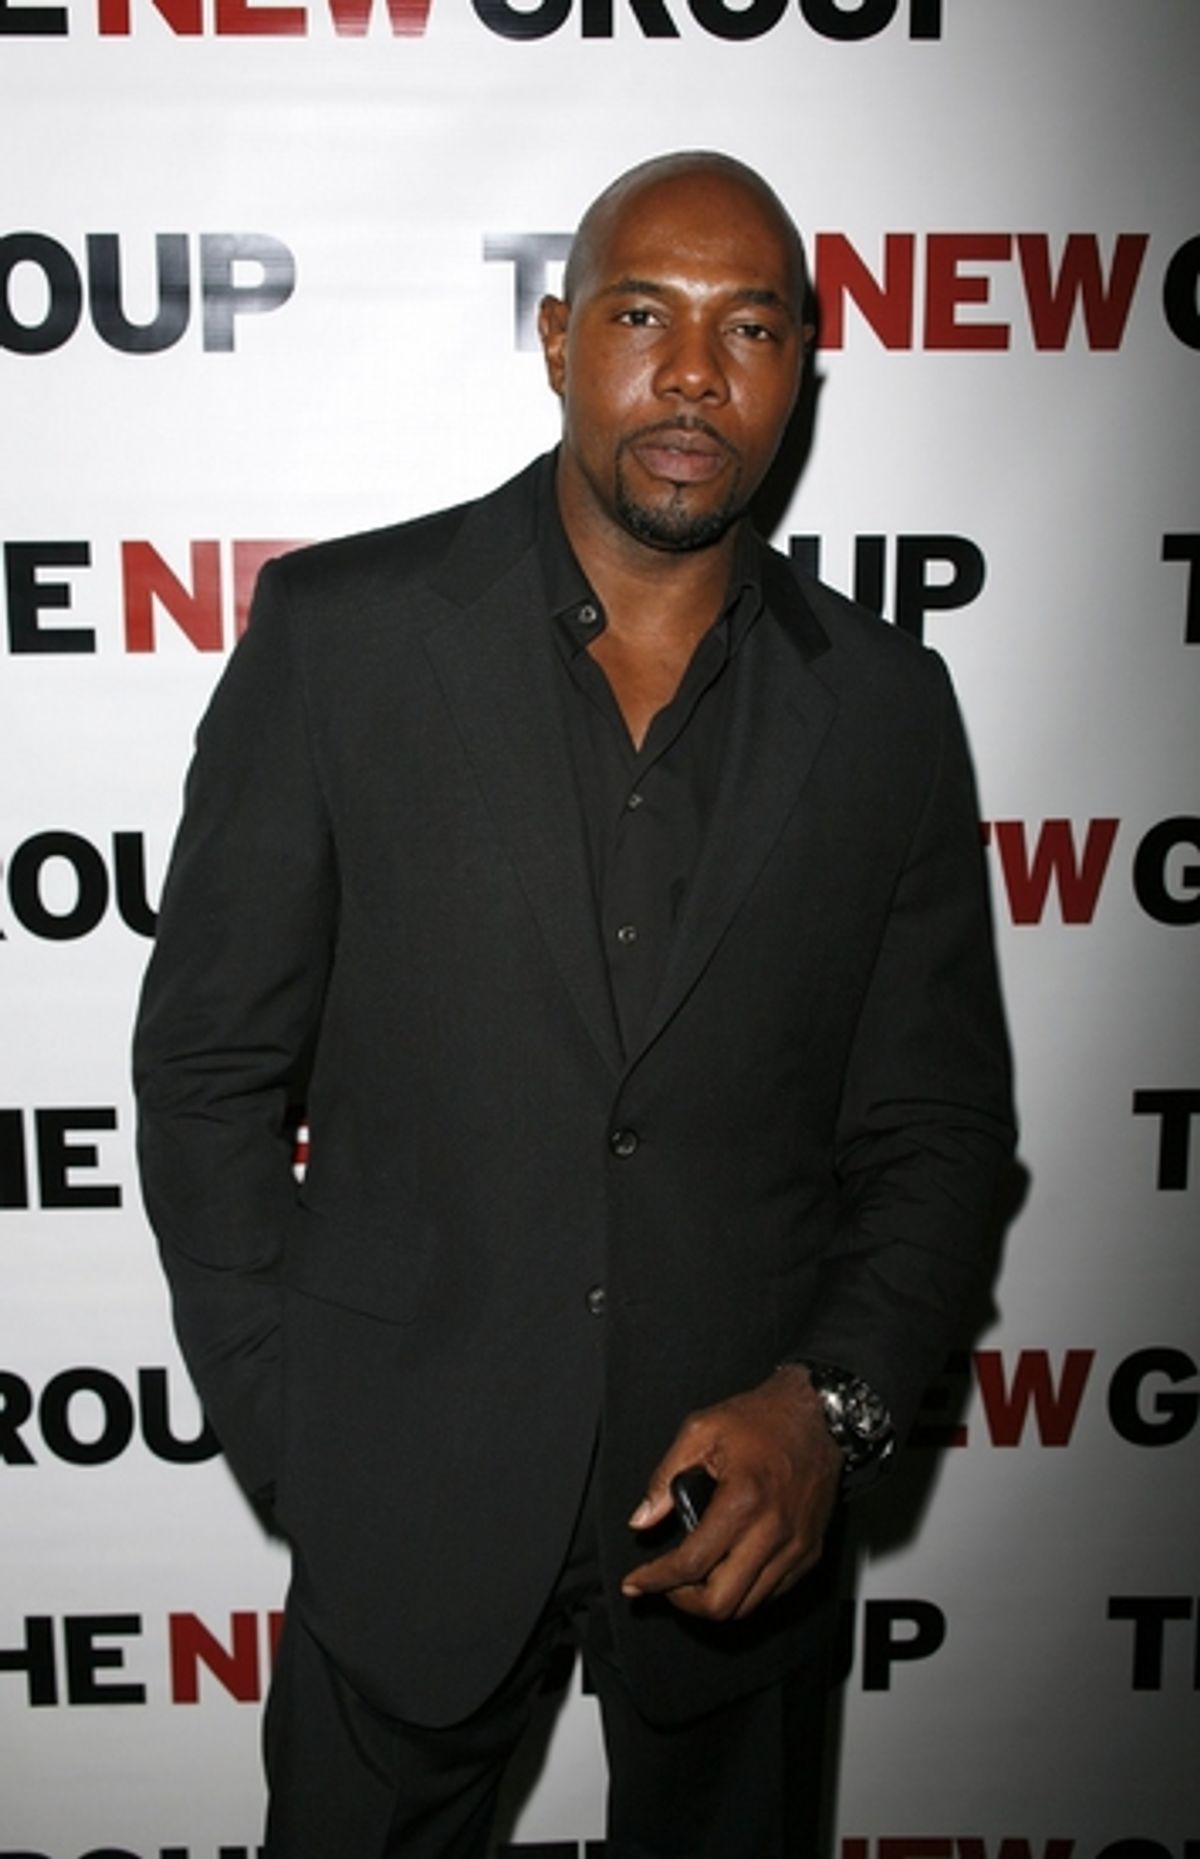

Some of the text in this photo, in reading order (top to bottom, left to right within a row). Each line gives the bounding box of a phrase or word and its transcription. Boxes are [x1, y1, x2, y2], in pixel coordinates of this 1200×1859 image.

[0, 232, 297, 355] OUP
[814, 233, 1150, 351] NEW
[0, 831, 160, 941] OU
[978, 818, 1121, 926] W
[168, 1611, 285, 1704] N
[1108, 1595, 1200, 1691] T
